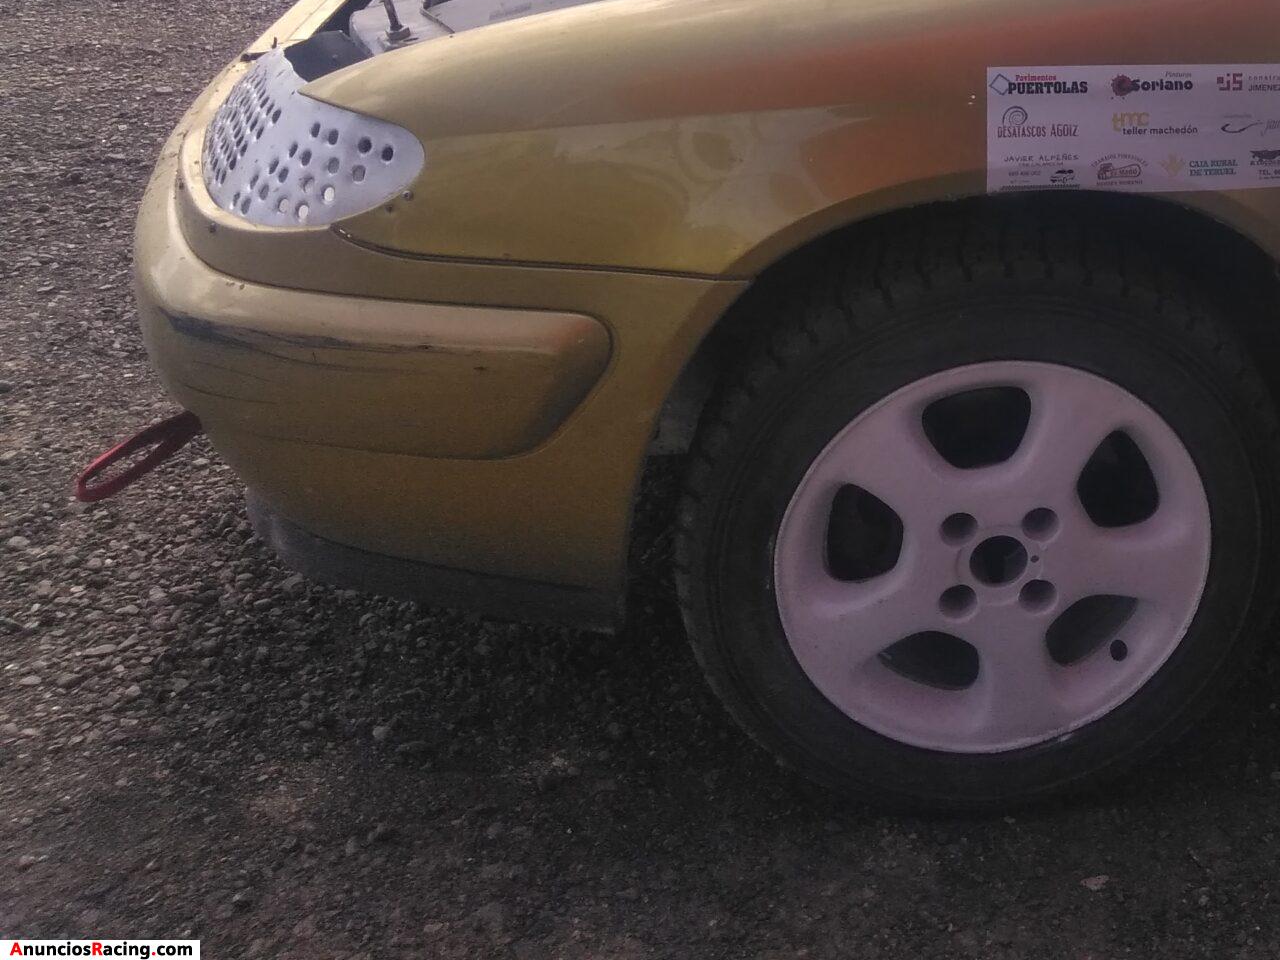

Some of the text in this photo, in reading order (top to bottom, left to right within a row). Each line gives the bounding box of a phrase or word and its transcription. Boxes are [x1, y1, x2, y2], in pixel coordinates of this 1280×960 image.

[1015, 74, 1057, 82] Pavimentos
[1007, 81, 1089, 95] PUERTOLAS
[998, 126, 1047, 139] DESATASCOS
[1003, 155, 1034, 163] JAVIER
